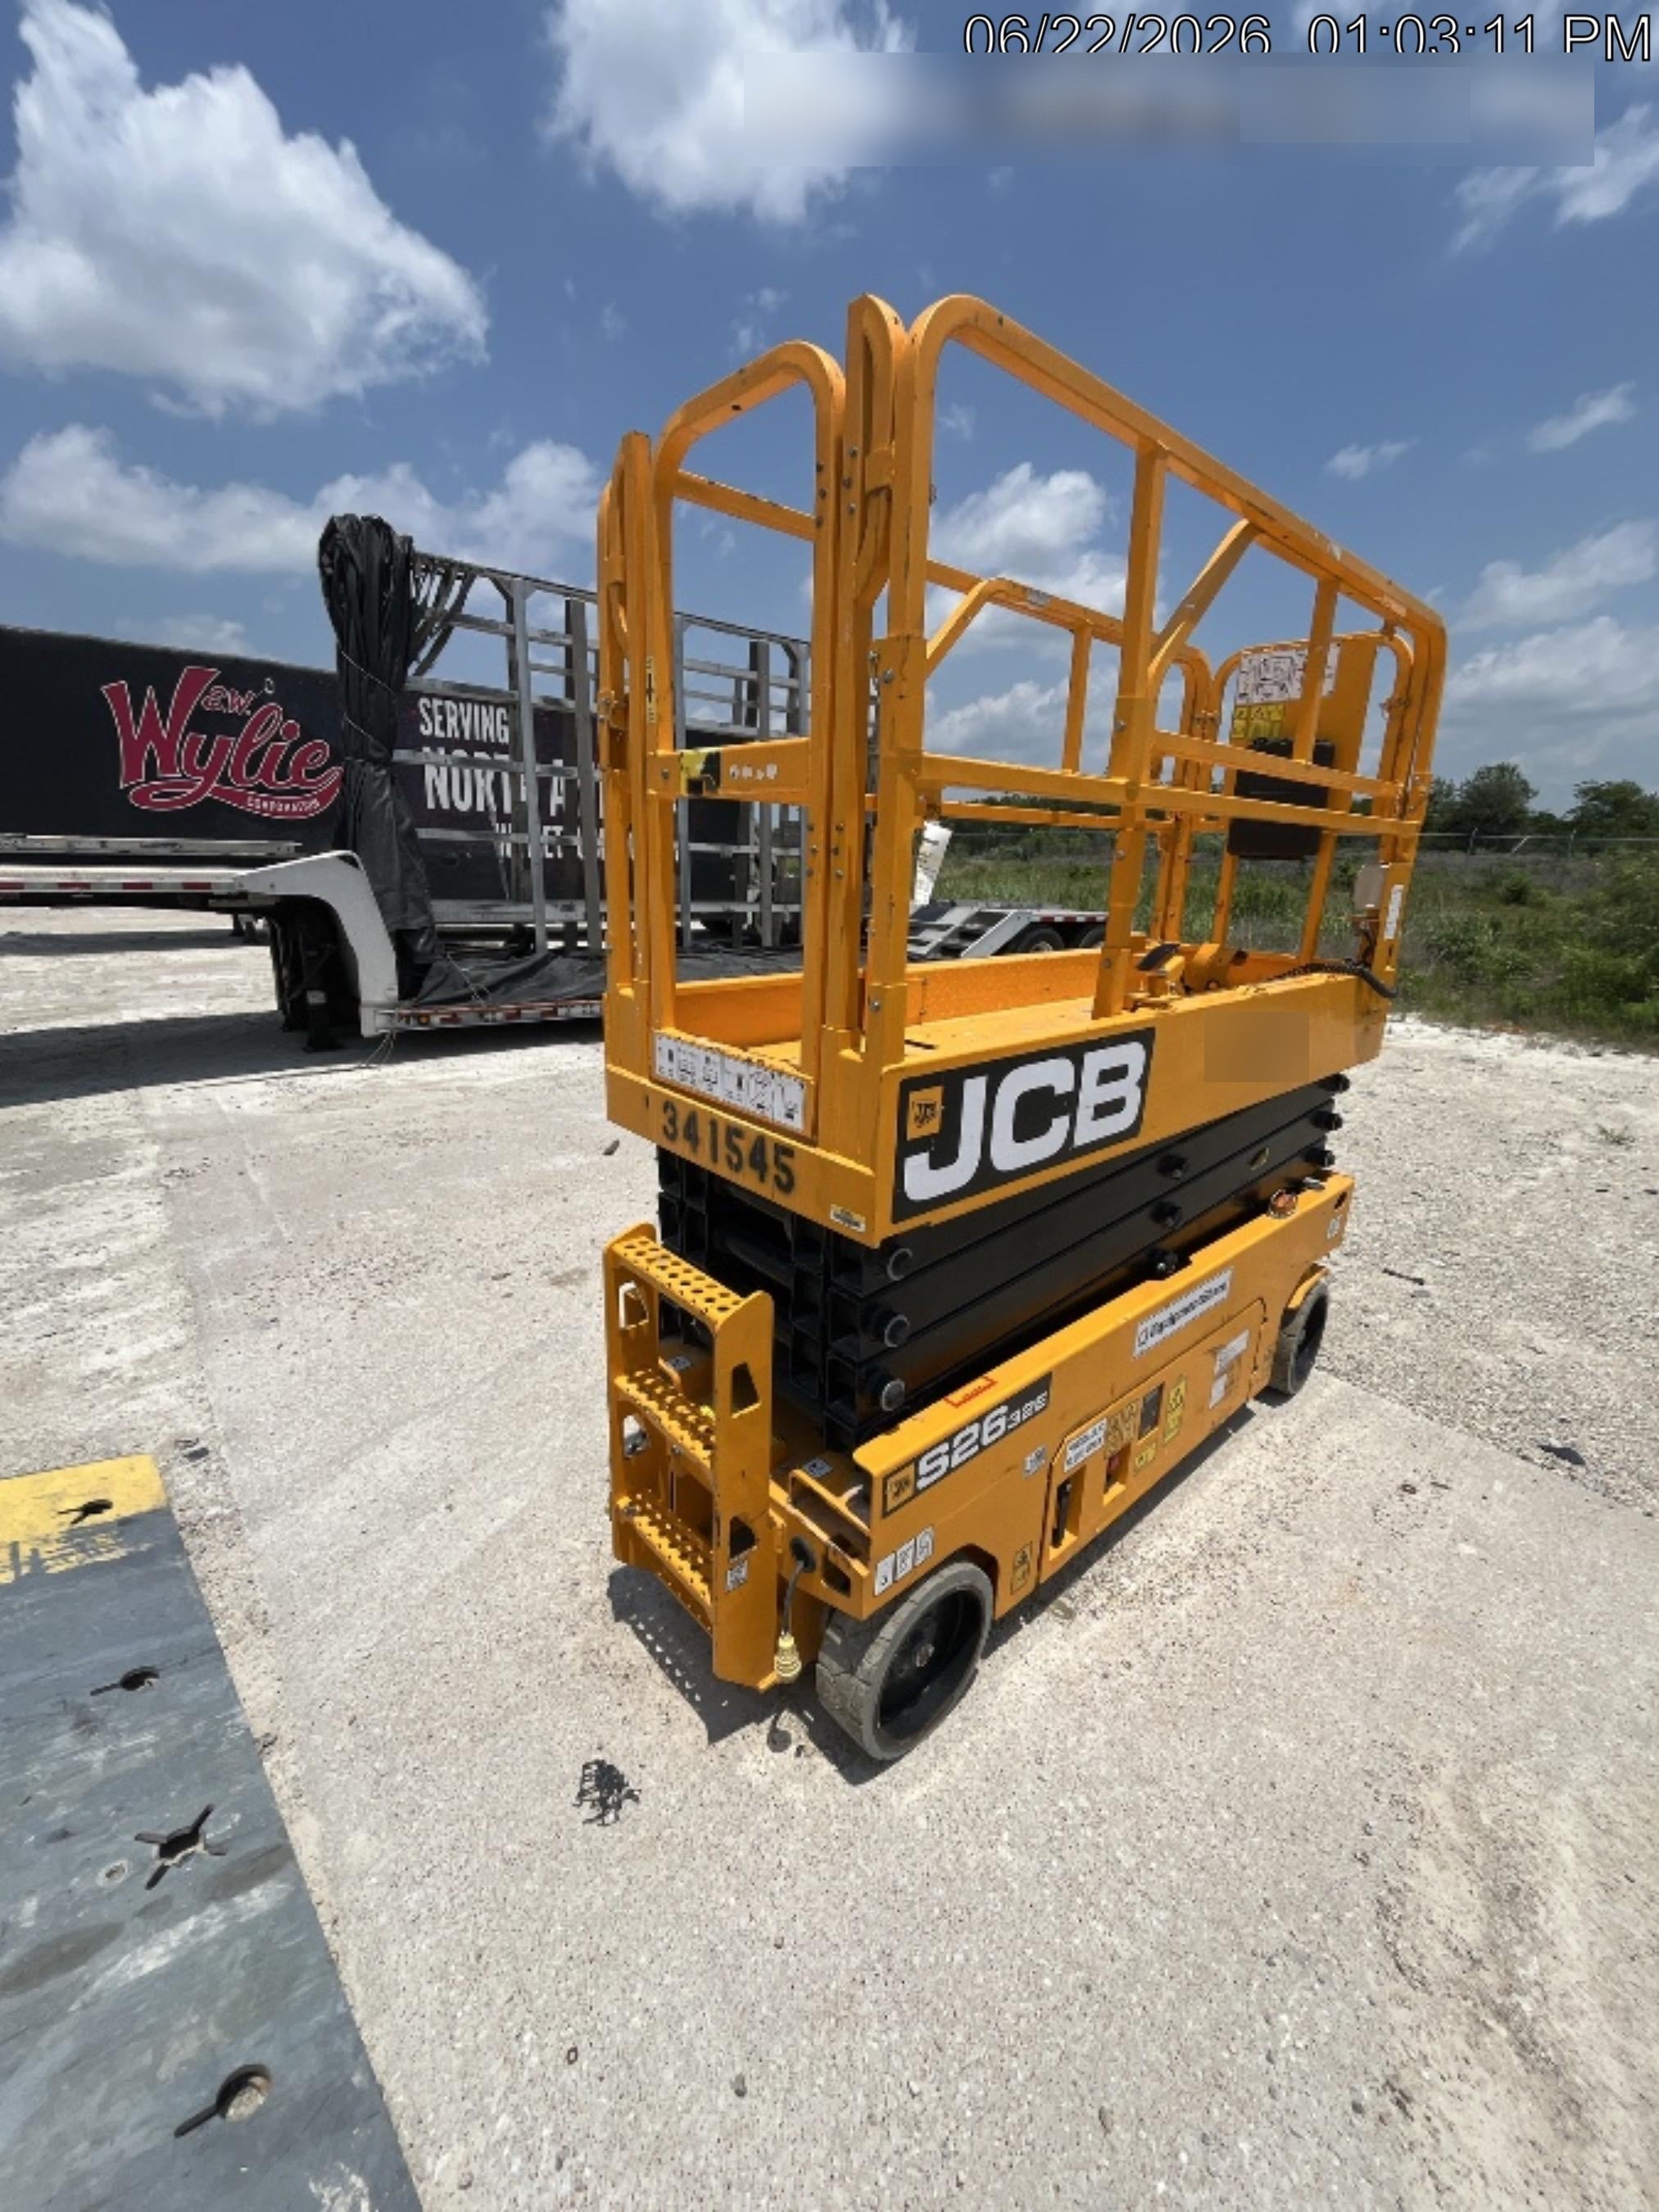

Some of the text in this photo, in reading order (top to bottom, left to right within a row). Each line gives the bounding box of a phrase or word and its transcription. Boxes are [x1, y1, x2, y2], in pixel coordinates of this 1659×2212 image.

[100, 664, 344, 819] Wylie
[418, 696, 510, 744] SERVING
[661, 1099, 796, 1195] 341545
[903, 1040, 1147, 1202] JCB
